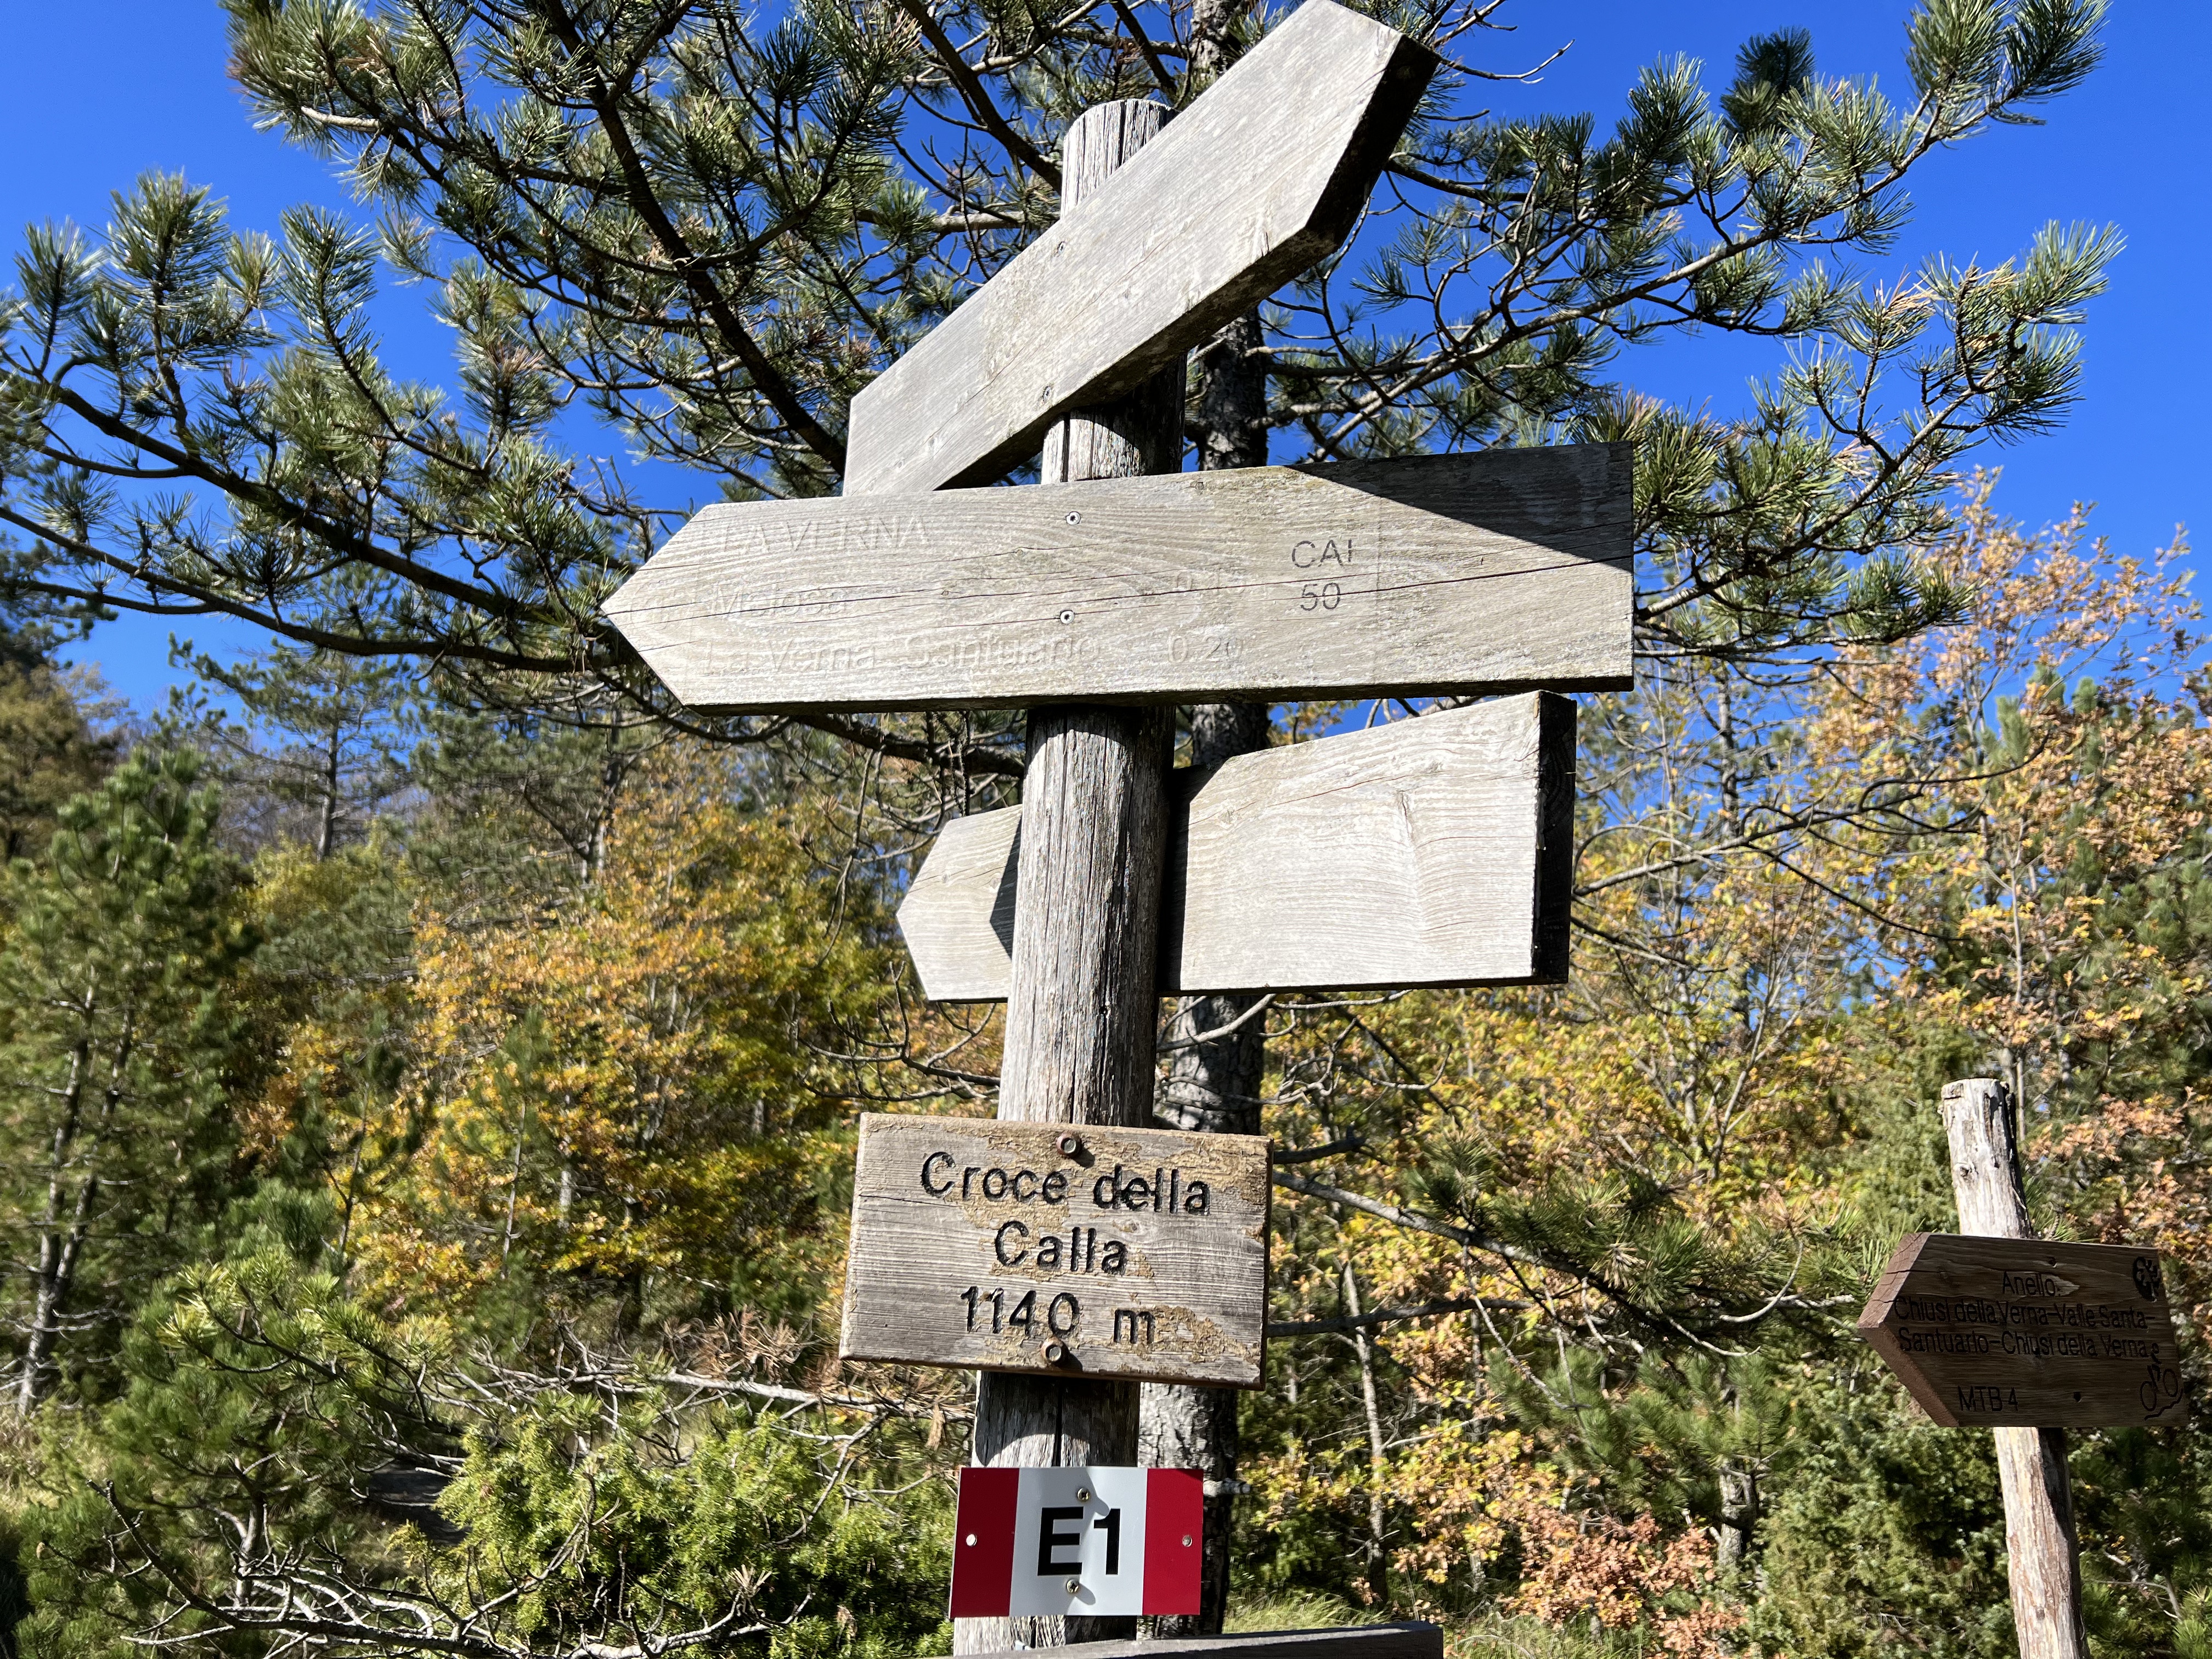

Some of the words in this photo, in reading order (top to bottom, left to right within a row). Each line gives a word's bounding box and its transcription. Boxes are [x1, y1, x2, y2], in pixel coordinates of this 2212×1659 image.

[783, 515, 930, 552] VERNA
[1291, 538, 1352, 568] CAI
[1300, 582, 1341, 611] 50
[768, 639, 877, 673] Verna
[920, 1150, 1069, 1205] Croce
[1093, 1164, 1210, 1215] della
[994, 1220, 1128, 1276] Calla
[960, 1285, 1081, 1339] 1140
[1113, 1308, 1156, 1345] m
[1894, 1295, 1951, 1322] Chiusi
[1954, 1299, 1998, 1324] della
[2058, 1332, 2098, 1356] della
[2099, 1333, 2150, 1358] Verna
[1957, 1385, 2003, 1412] MTB
[2008, 1386, 2019, 1412] 4
[1037, 1506, 1121, 1577] E1
